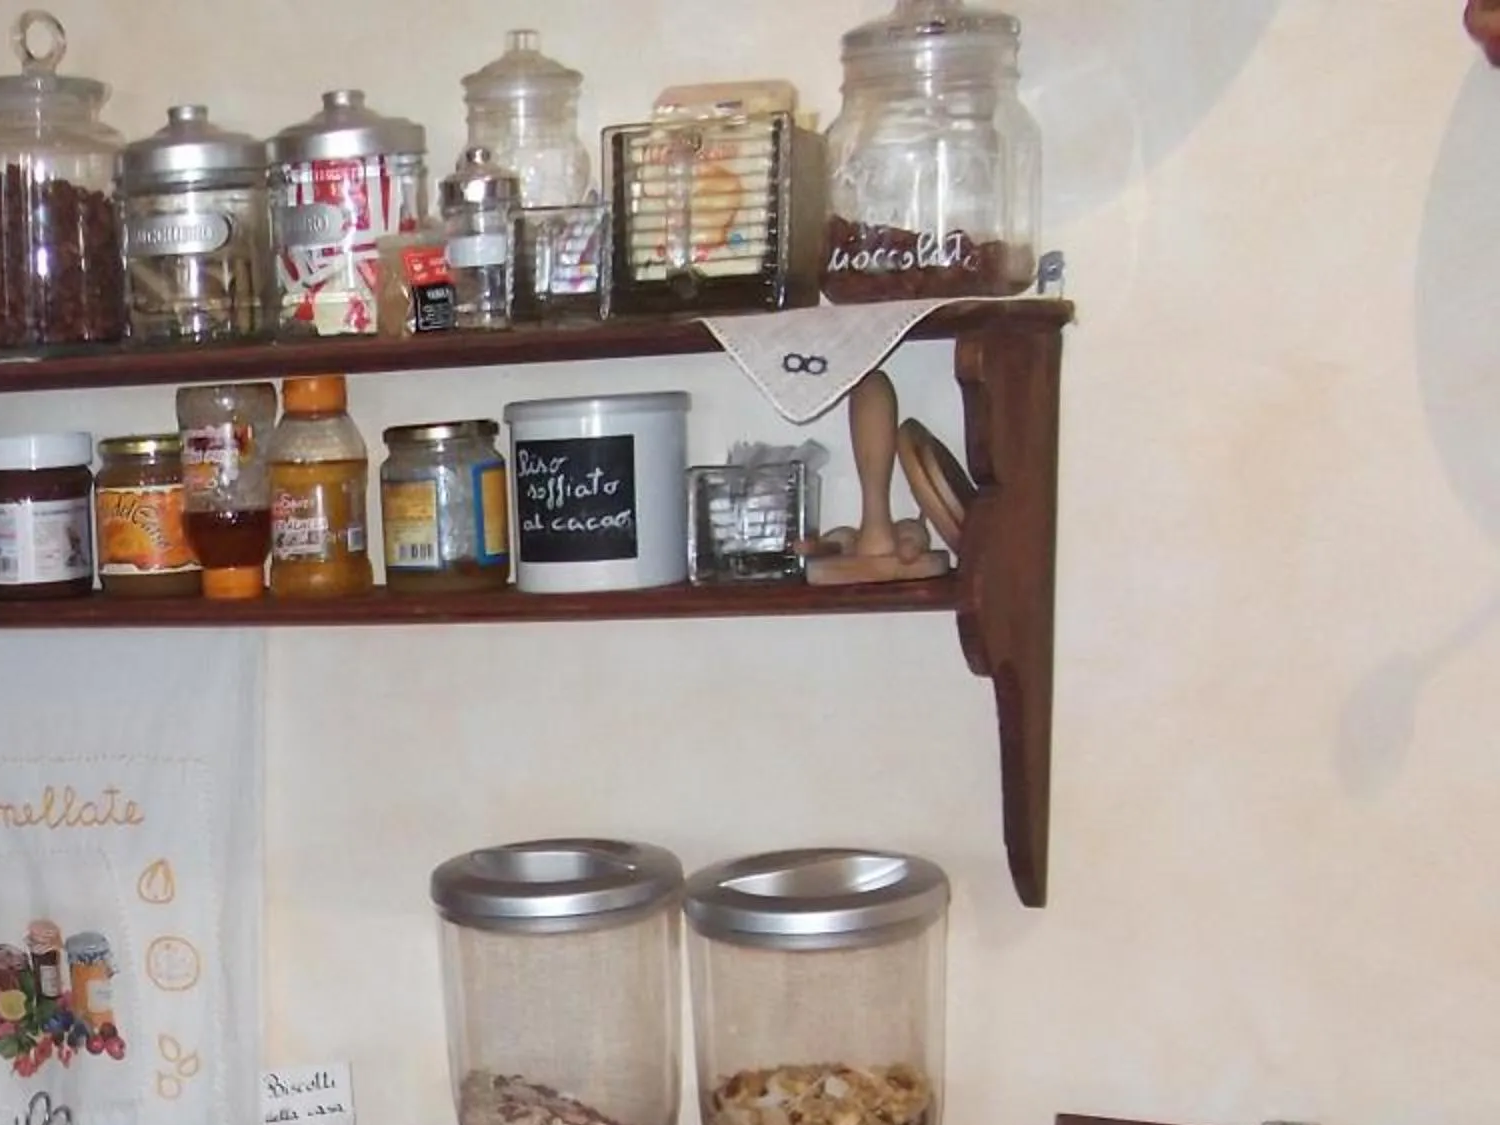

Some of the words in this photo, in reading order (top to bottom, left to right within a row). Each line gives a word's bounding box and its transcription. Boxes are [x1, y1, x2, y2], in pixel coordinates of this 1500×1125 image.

[526, 466, 621, 511] soffiato
[522, 512, 545, 532] al
[551, 509, 632, 532] cacao
